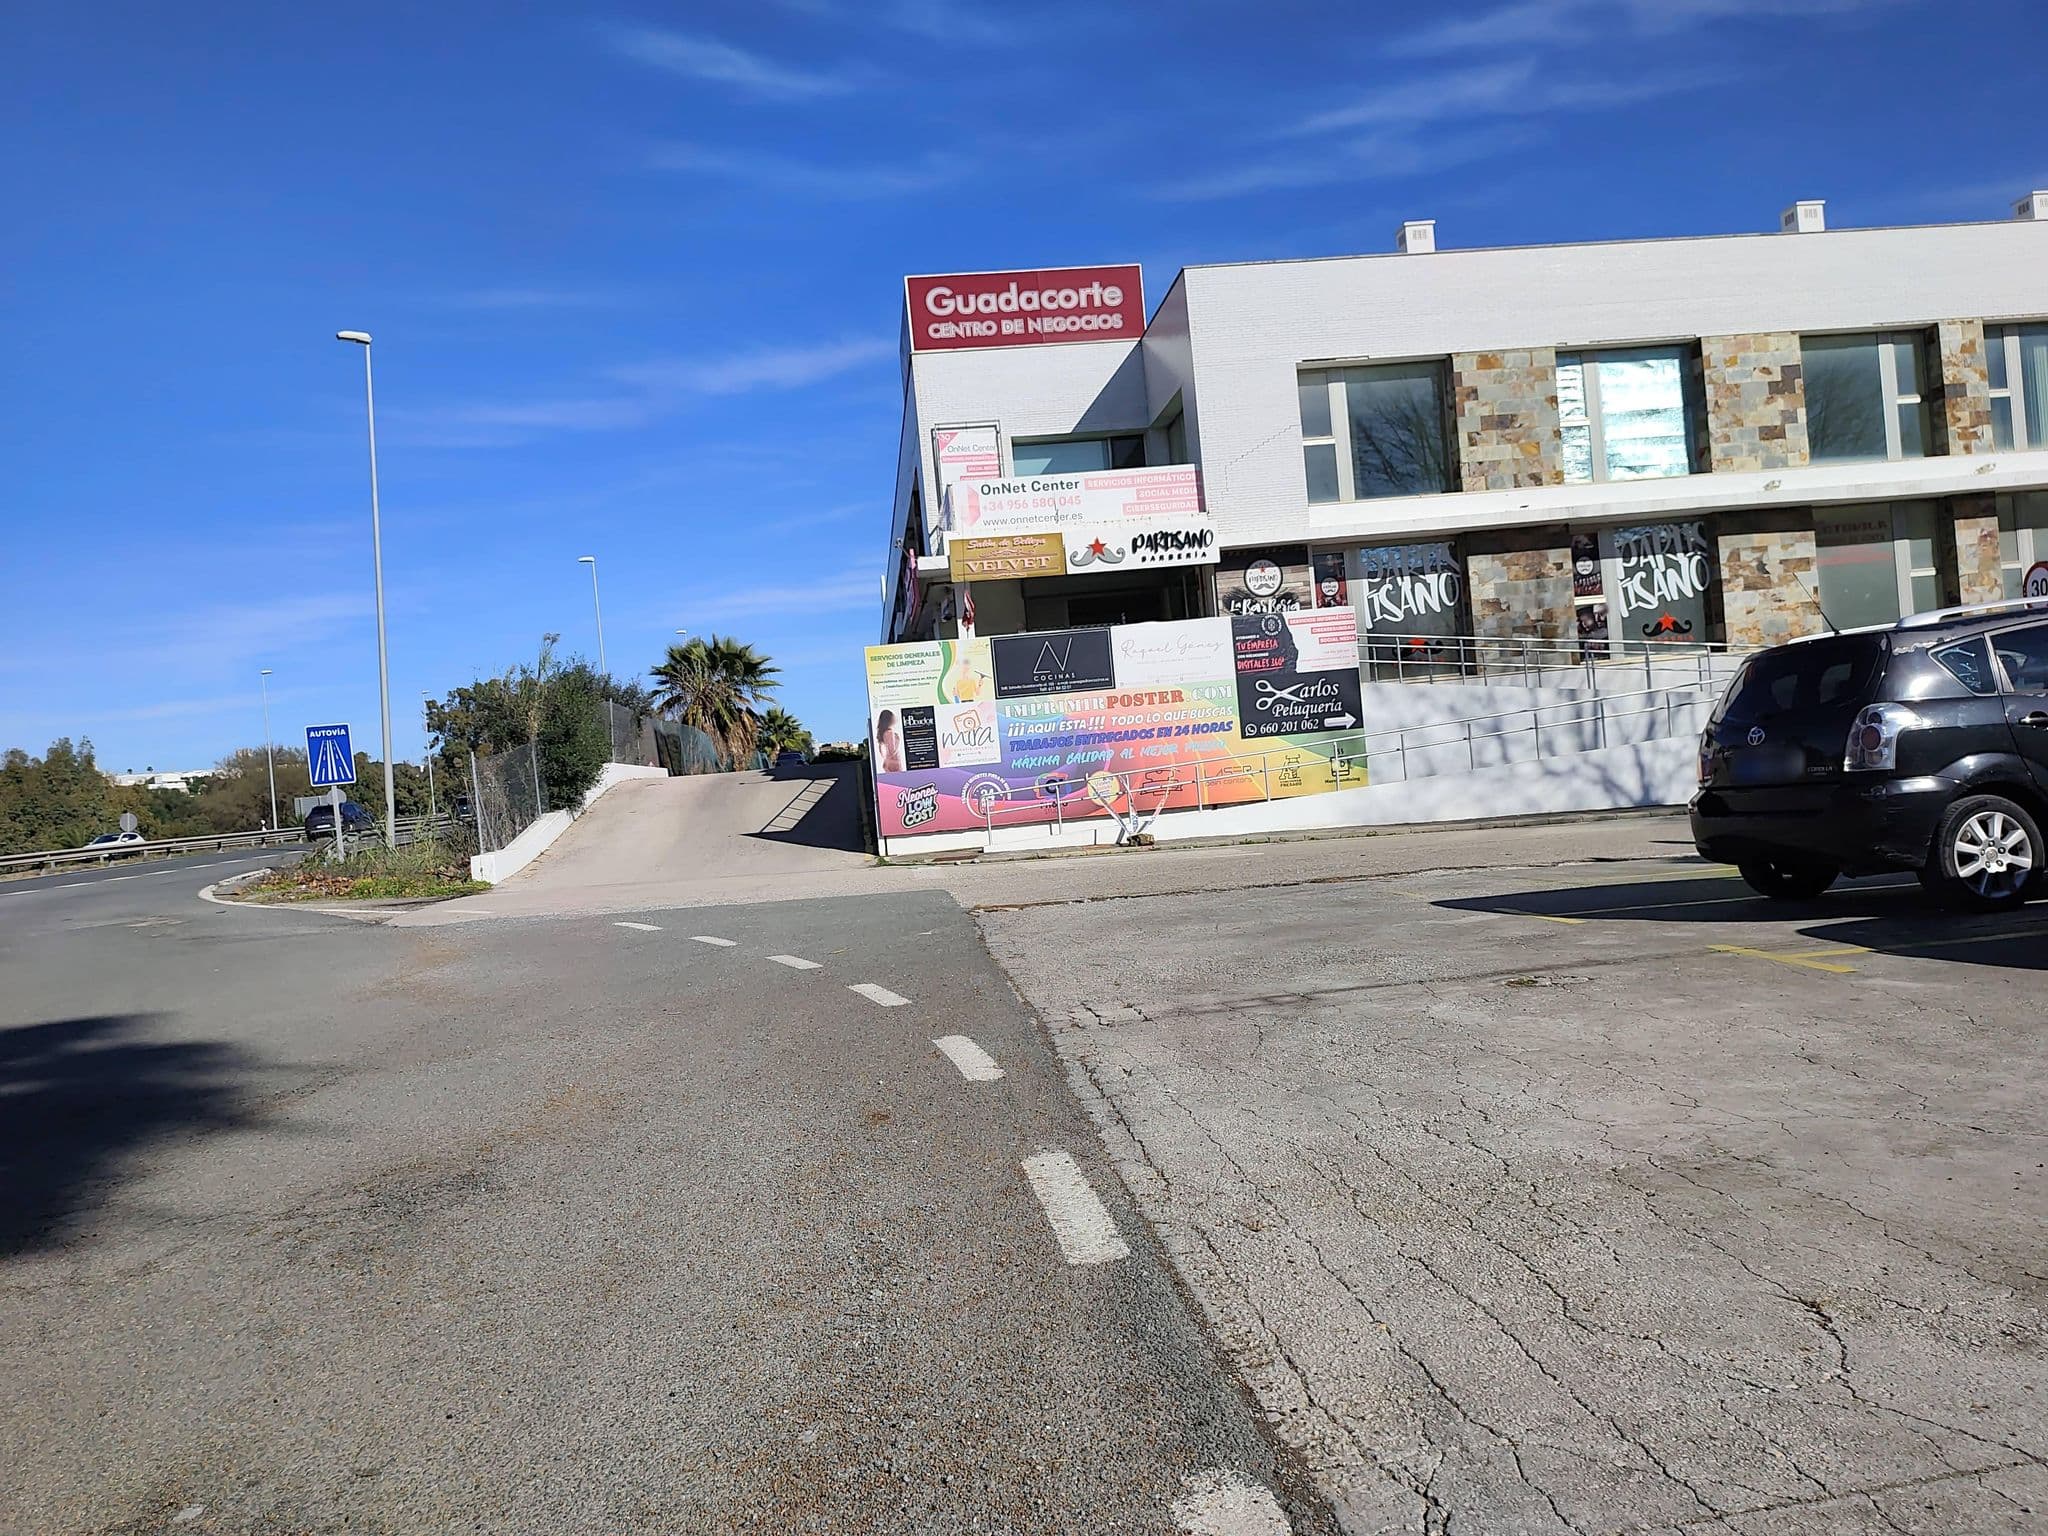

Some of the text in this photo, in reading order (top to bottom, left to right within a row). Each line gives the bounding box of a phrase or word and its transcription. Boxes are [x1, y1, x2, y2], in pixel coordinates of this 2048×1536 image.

[925, 281, 1124, 316] Guadacorte
[928, 313, 1123, 339] CENTRO DE NEGOCIOS
[981, 480, 1080, 496] OnNet Center
[1087, 478, 1133, 488] SERVICIOS
[1138, 489, 1170, 498] SOCIAL
[1007, 499, 1028, 510] 956
[1032, 497, 1055, 508] 580
[1058, 495, 1081, 506] 045
[966, 557, 1050, 572] VELVET
[2031, 577, 2048, 597] 30
[1247, 639, 1279, 650] EMPRESA
[870, 650, 941, 661] SERVICIOS GENERALES
[897, 659, 926, 668] LIMPIEZA
[1237, 658, 1270, 669] DIGITALES
[1033, 672, 1076, 682] COCINAS
[1111, 714, 1144, 726] TODO
[1146, 712, 1161, 723] LO
[1163, 709, 1187, 721] QUE
[1189, 706, 1233, 720] BUSCAS
[1272, 698, 1342, 719] Peluquería
[309, 728, 346, 737] AUTOVÍA
[1260, 719, 1319, 734] 660 201 062
[942, 726, 995, 749] mira
[1010, 720, 1233, 751] TRABAJOS ENTREGADOS EN 24 HORAS
[1011, 754, 1060, 769] MÁXIMA
[897, 786, 938, 808] Neones
[908, 796, 933, 815] LOW
[905, 807, 934, 826] COST
